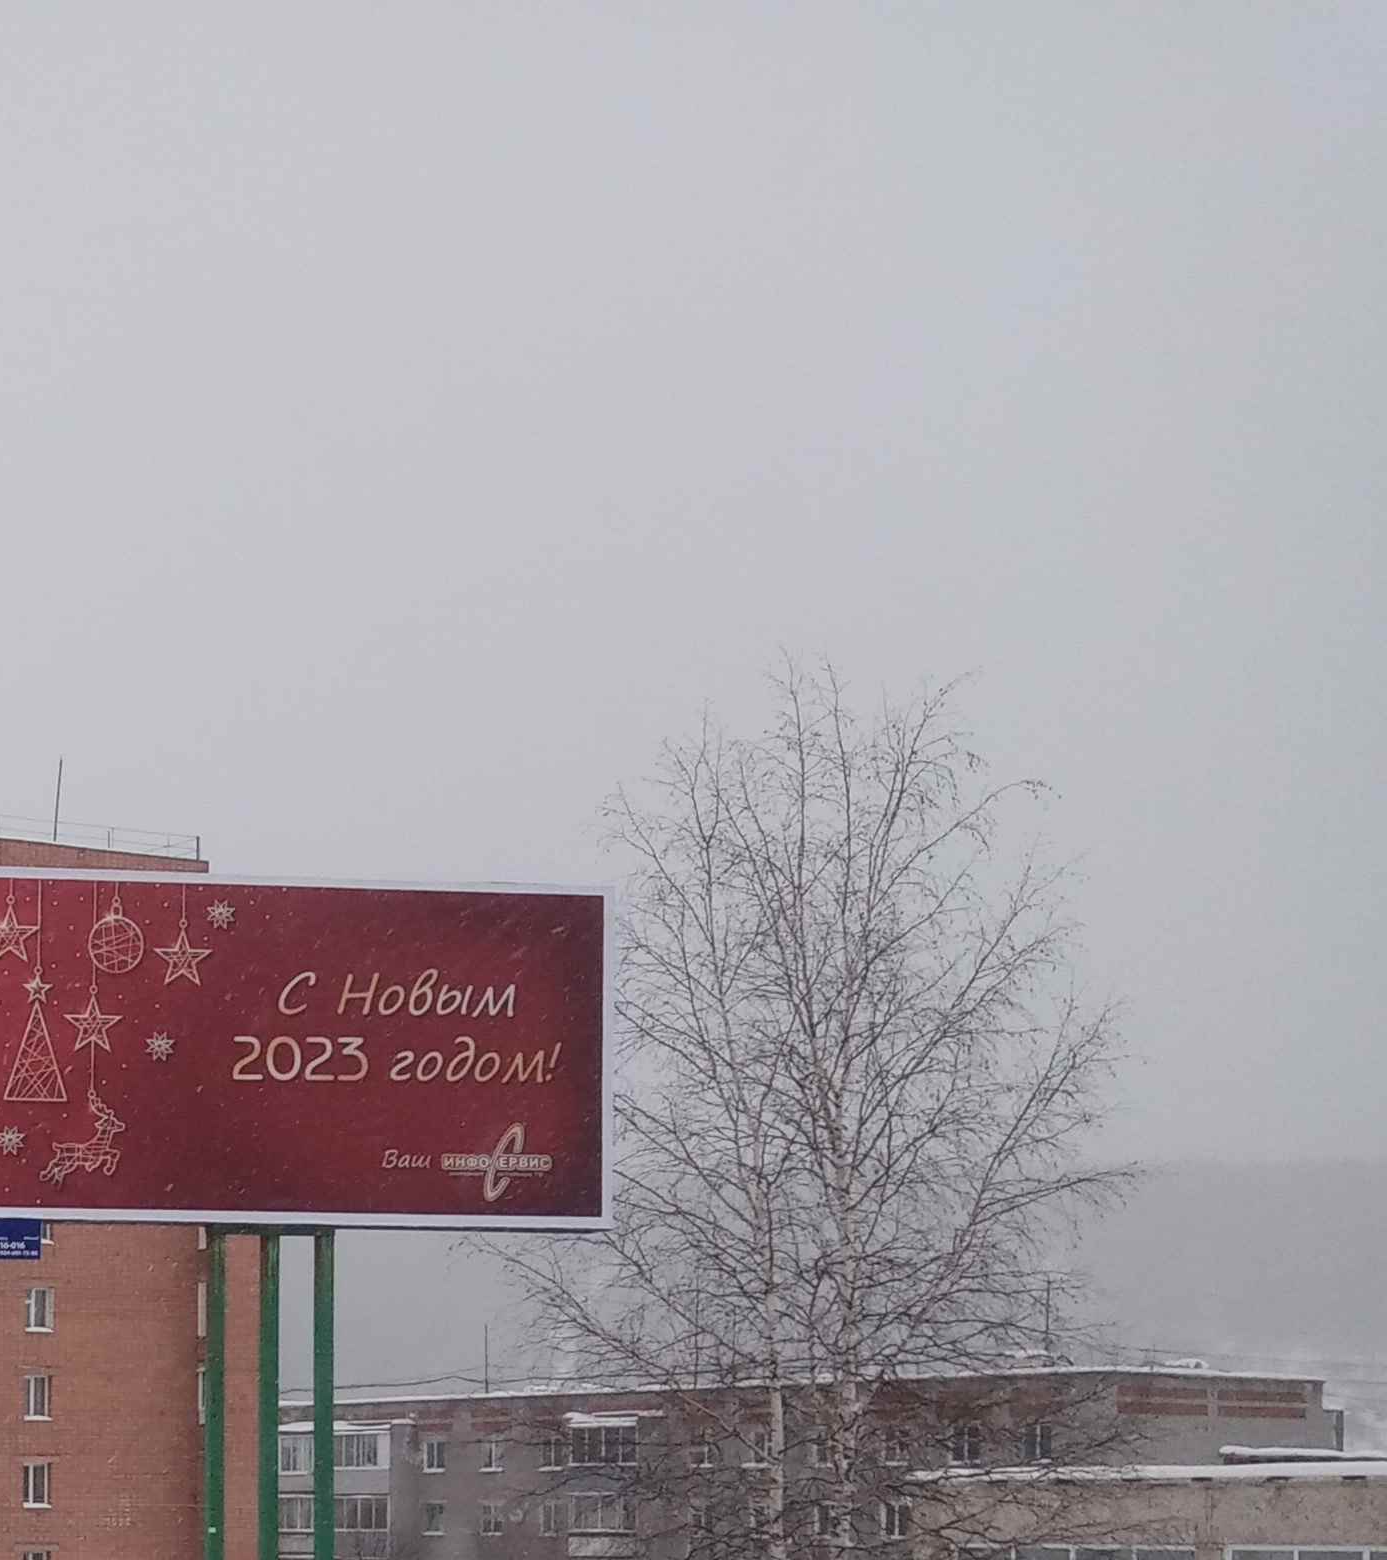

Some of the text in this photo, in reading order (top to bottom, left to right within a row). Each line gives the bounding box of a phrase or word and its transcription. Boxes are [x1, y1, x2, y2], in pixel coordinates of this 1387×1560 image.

[278, 968, 516, 1018] С Новым
[231, 1035, 563, 1083] 2023 годом!
[381, 1149, 431, 1169] Ваш
